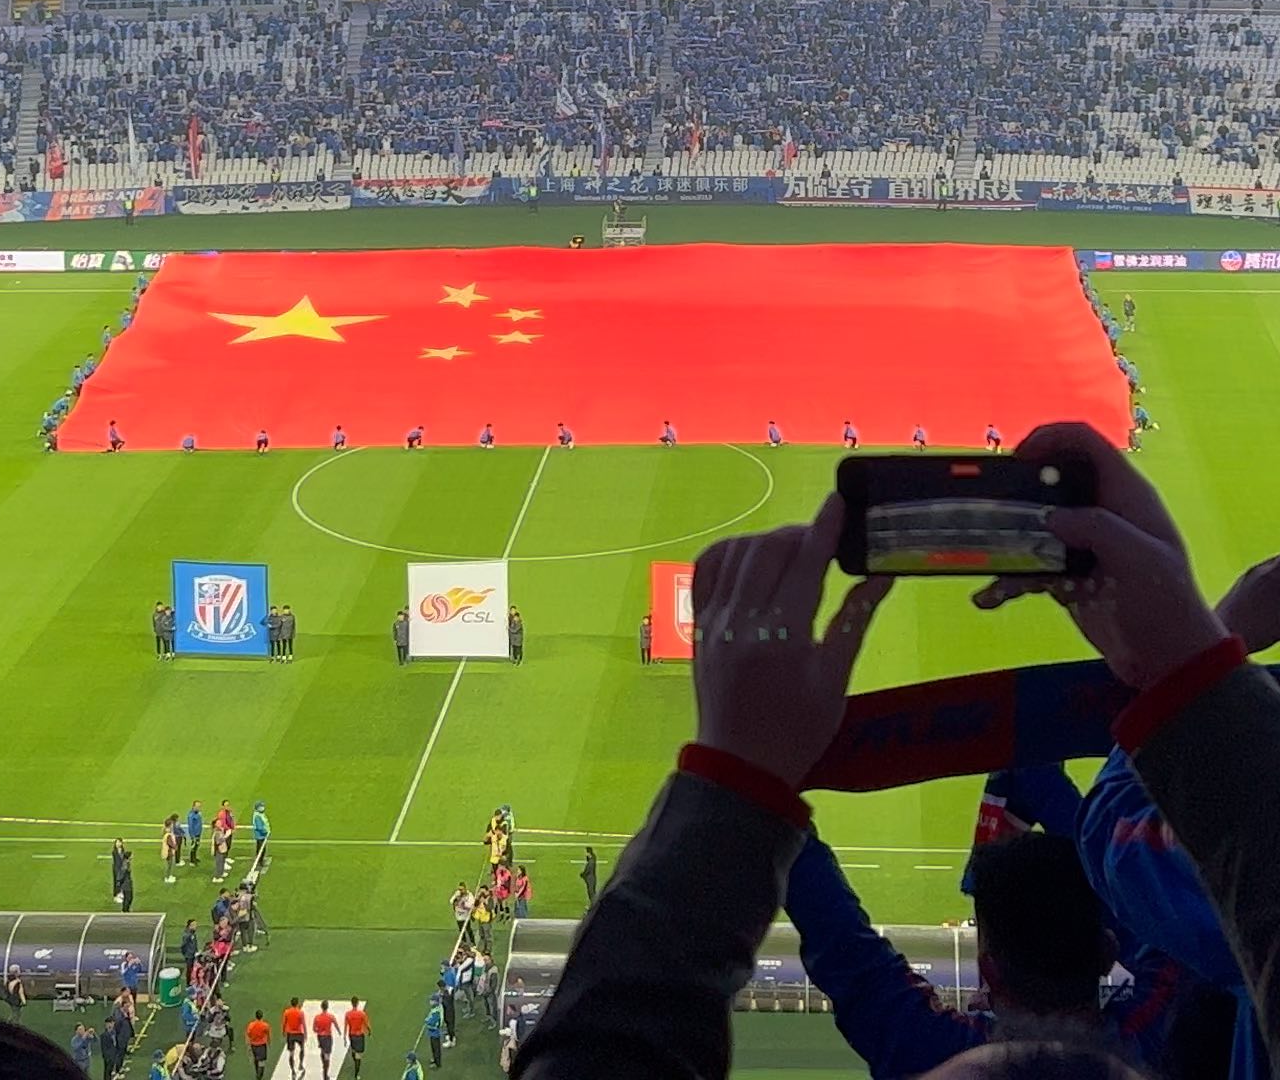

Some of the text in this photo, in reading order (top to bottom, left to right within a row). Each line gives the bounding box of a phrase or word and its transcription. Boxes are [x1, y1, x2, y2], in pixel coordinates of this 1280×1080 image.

[541, 176, 749, 194] 上海 神之花 球迷俱乐部
[59, 192, 119, 204] DREAMS
[60, 204, 106, 216] MATES
[461, 611, 495, 624] CSL
